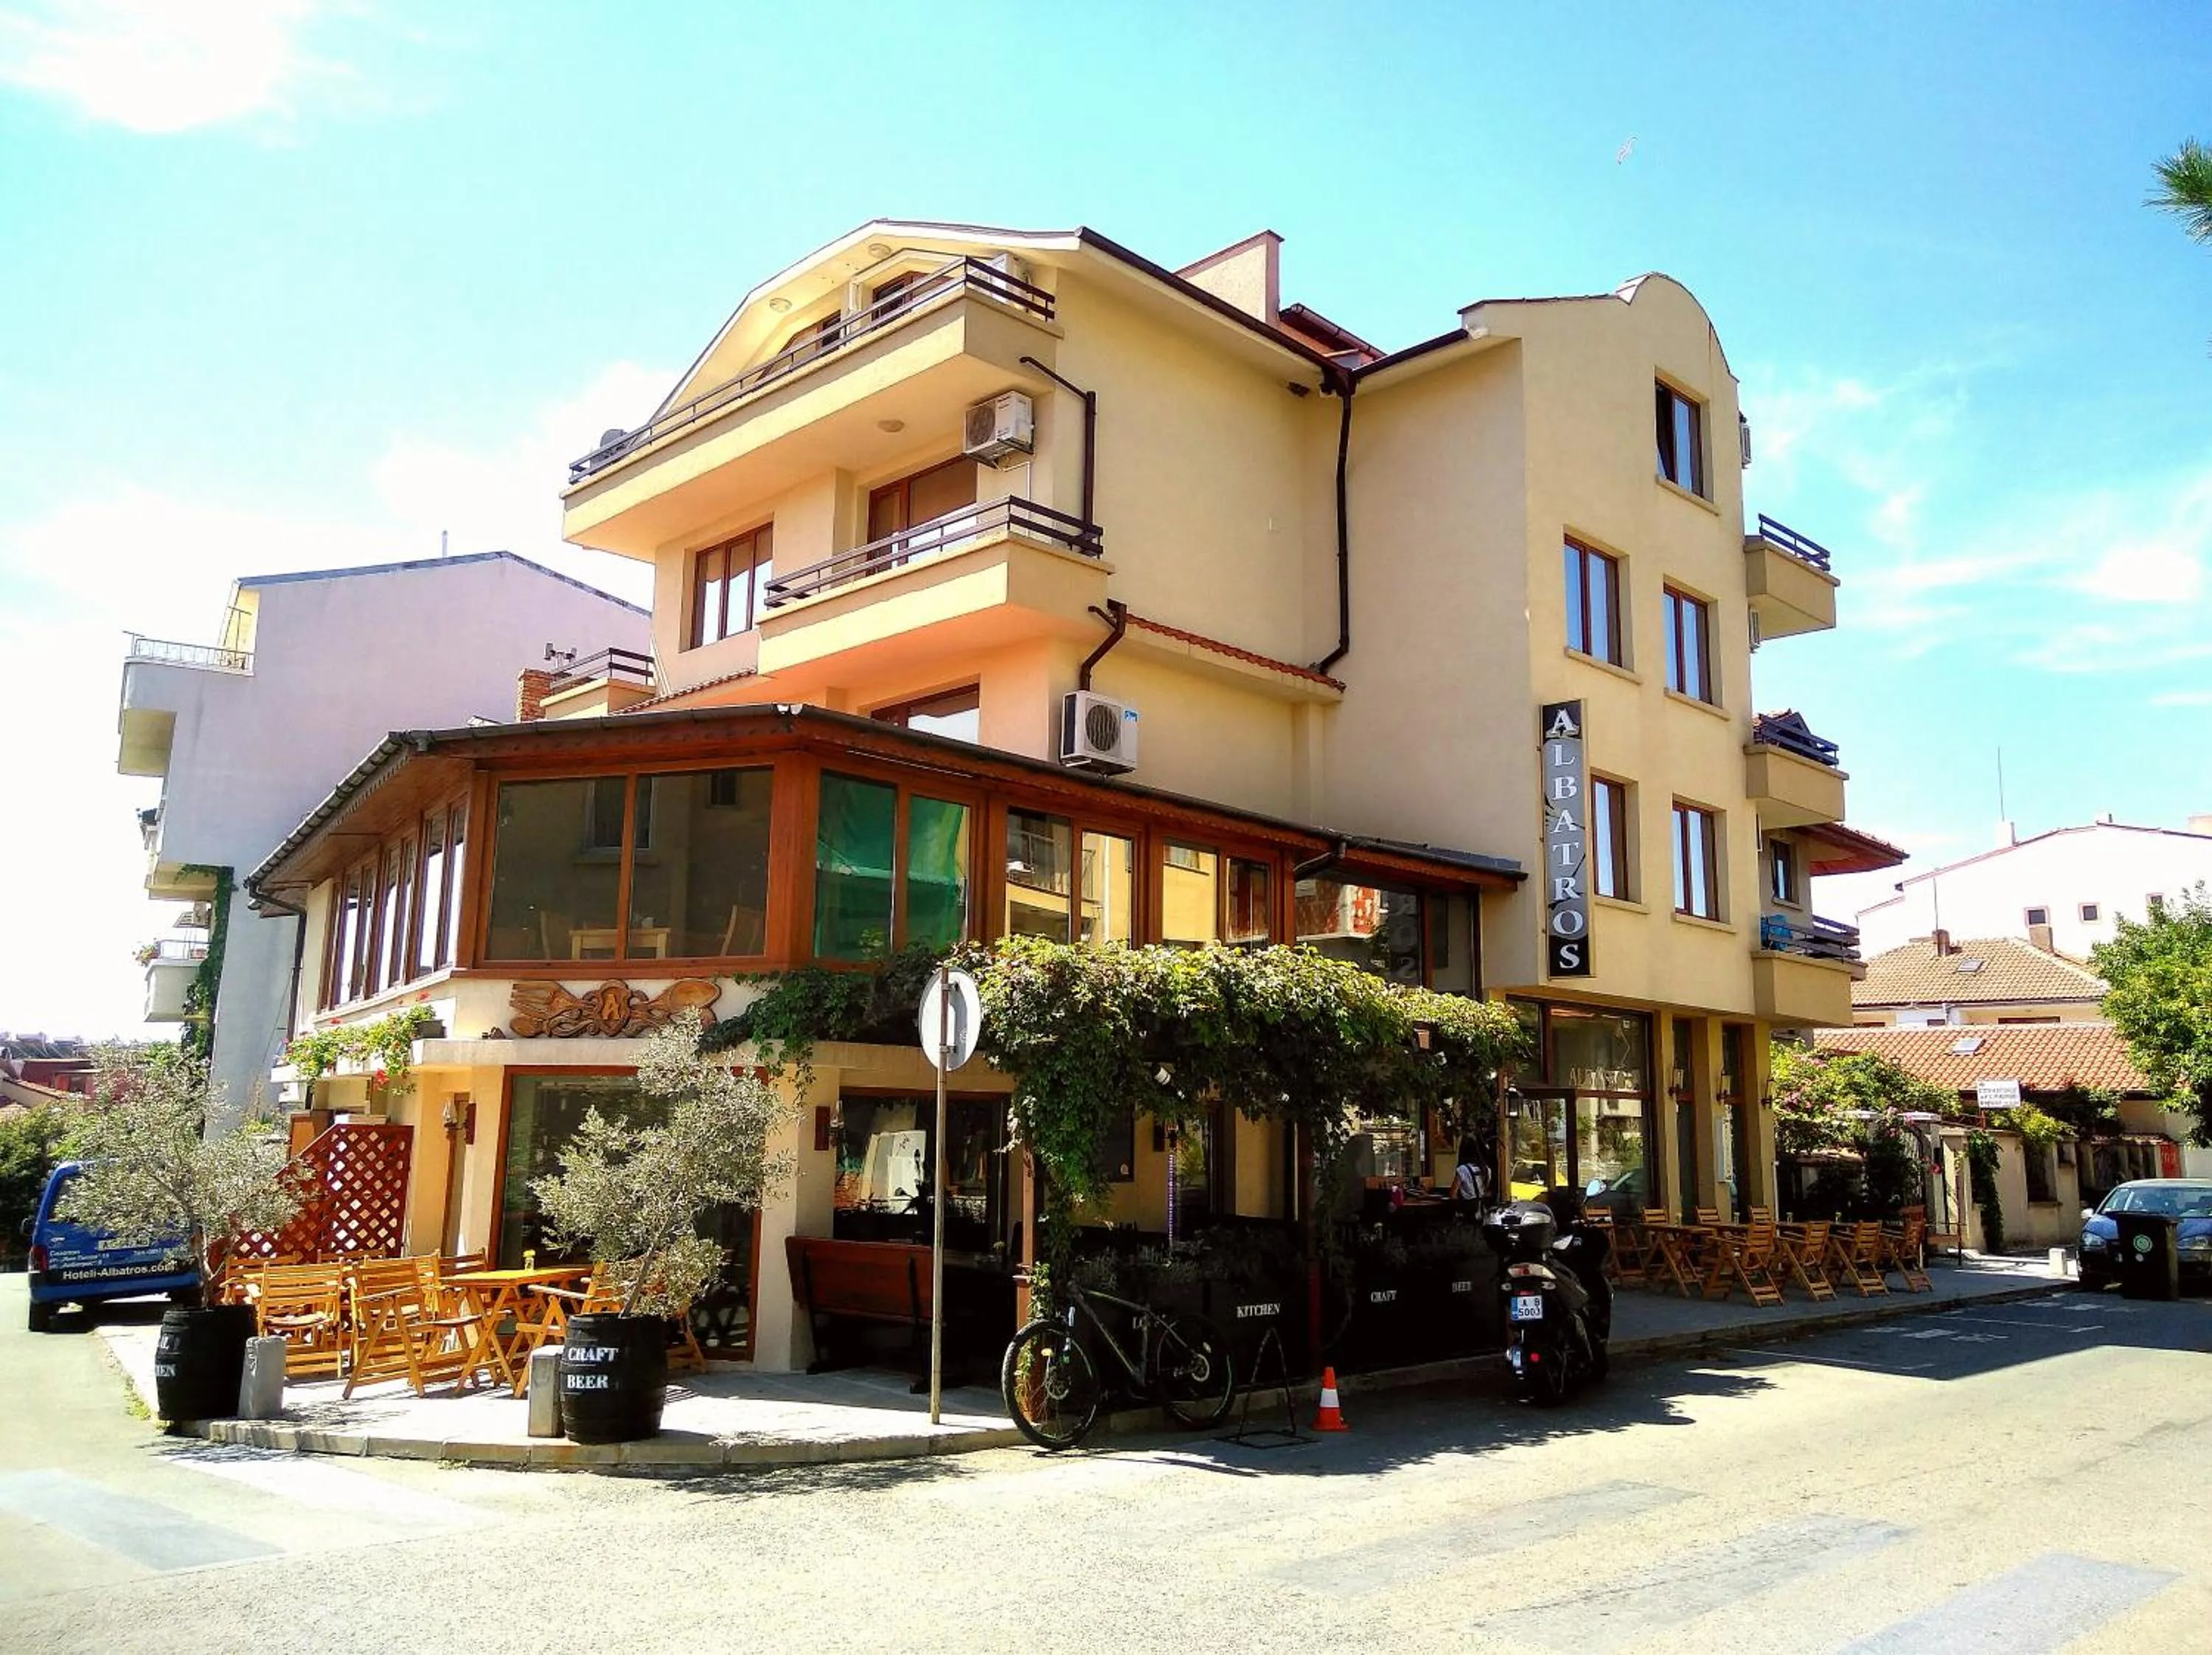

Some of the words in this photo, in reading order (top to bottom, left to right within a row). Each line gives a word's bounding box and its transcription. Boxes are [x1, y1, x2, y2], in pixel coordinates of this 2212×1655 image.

[1552, 709, 1584, 968] ALBATROS
[602, 993, 620, 1021] A
[1237, 1302, 1281, 1319] KITCHEN
[568, 1347, 619, 1362] CRAFT
[567, 1374, 609, 1389] BEER
